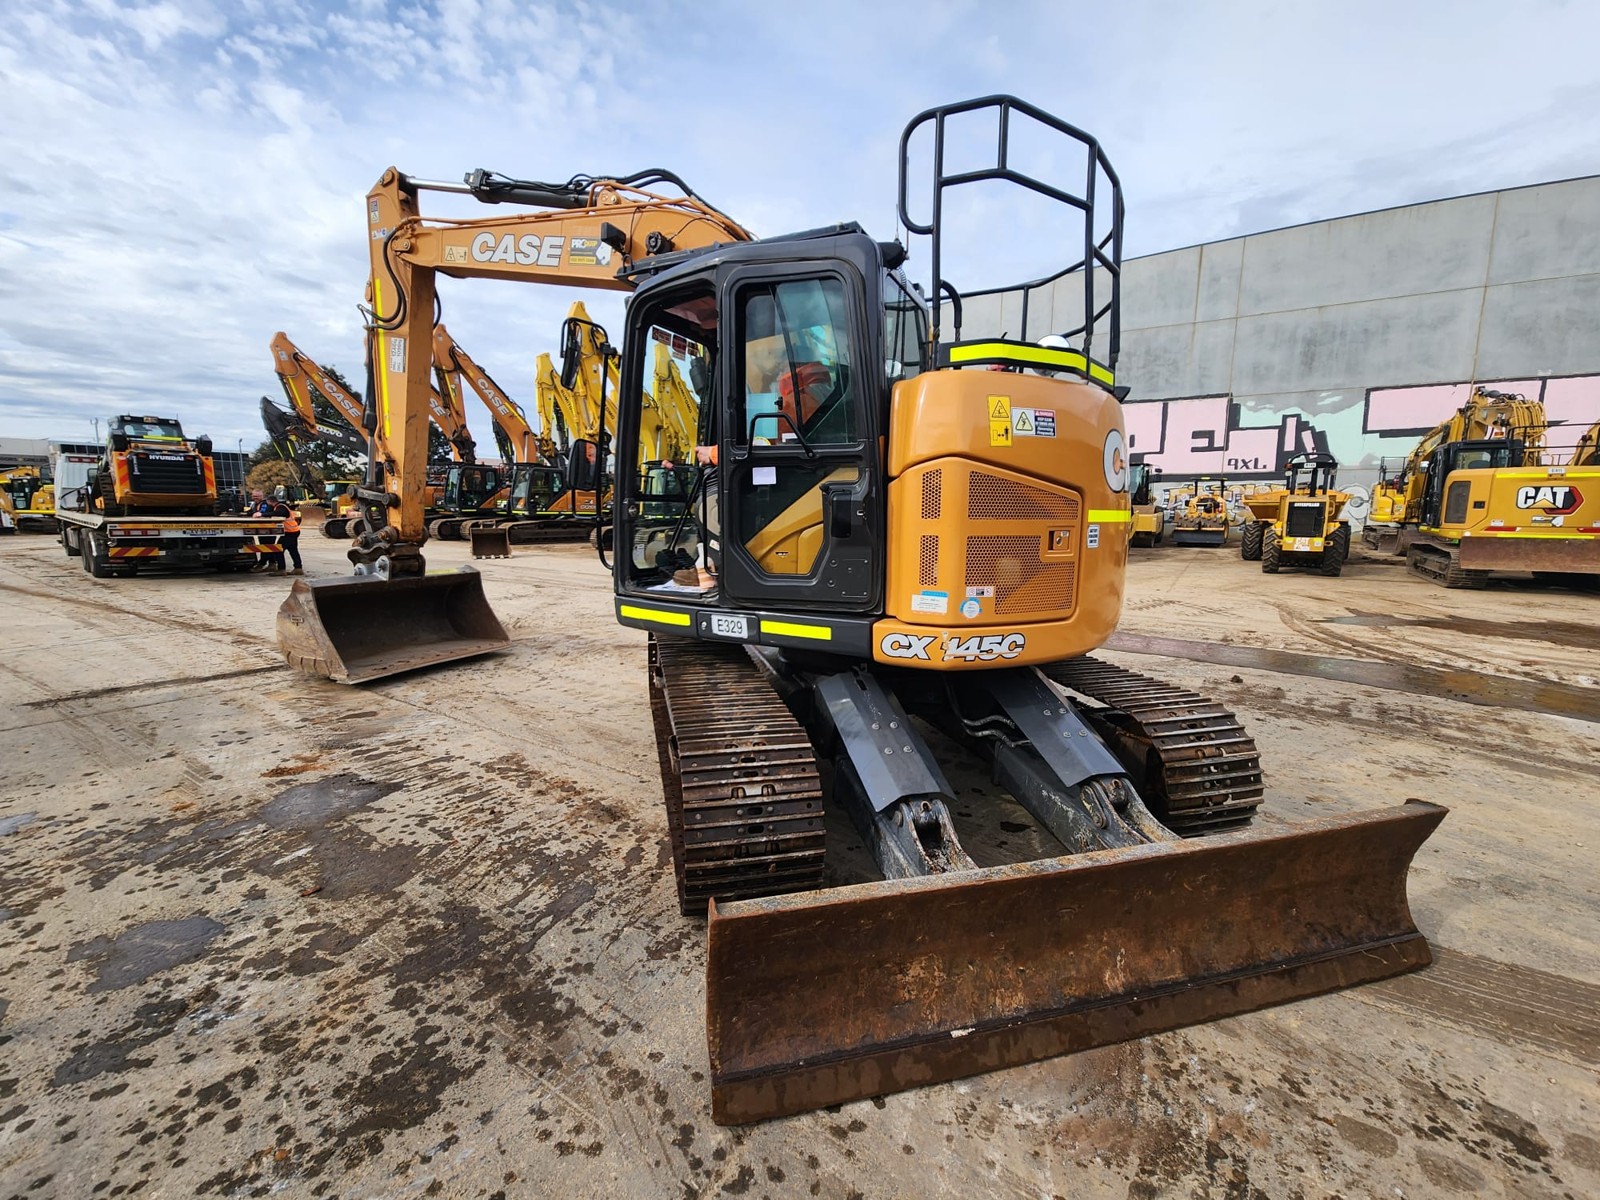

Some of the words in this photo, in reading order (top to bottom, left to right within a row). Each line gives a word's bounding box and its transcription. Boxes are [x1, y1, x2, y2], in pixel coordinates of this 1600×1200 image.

[471, 231, 566, 267] CASE
[324, 382, 361, 418] CASE
[477, 378, 510, 416] CASE
[1518, 486, 1570, 509] CAT
[717, 618, 743, 635] E329
[881, 633, 937, 661] CX
[940, 632, 1026, 662] 145C
